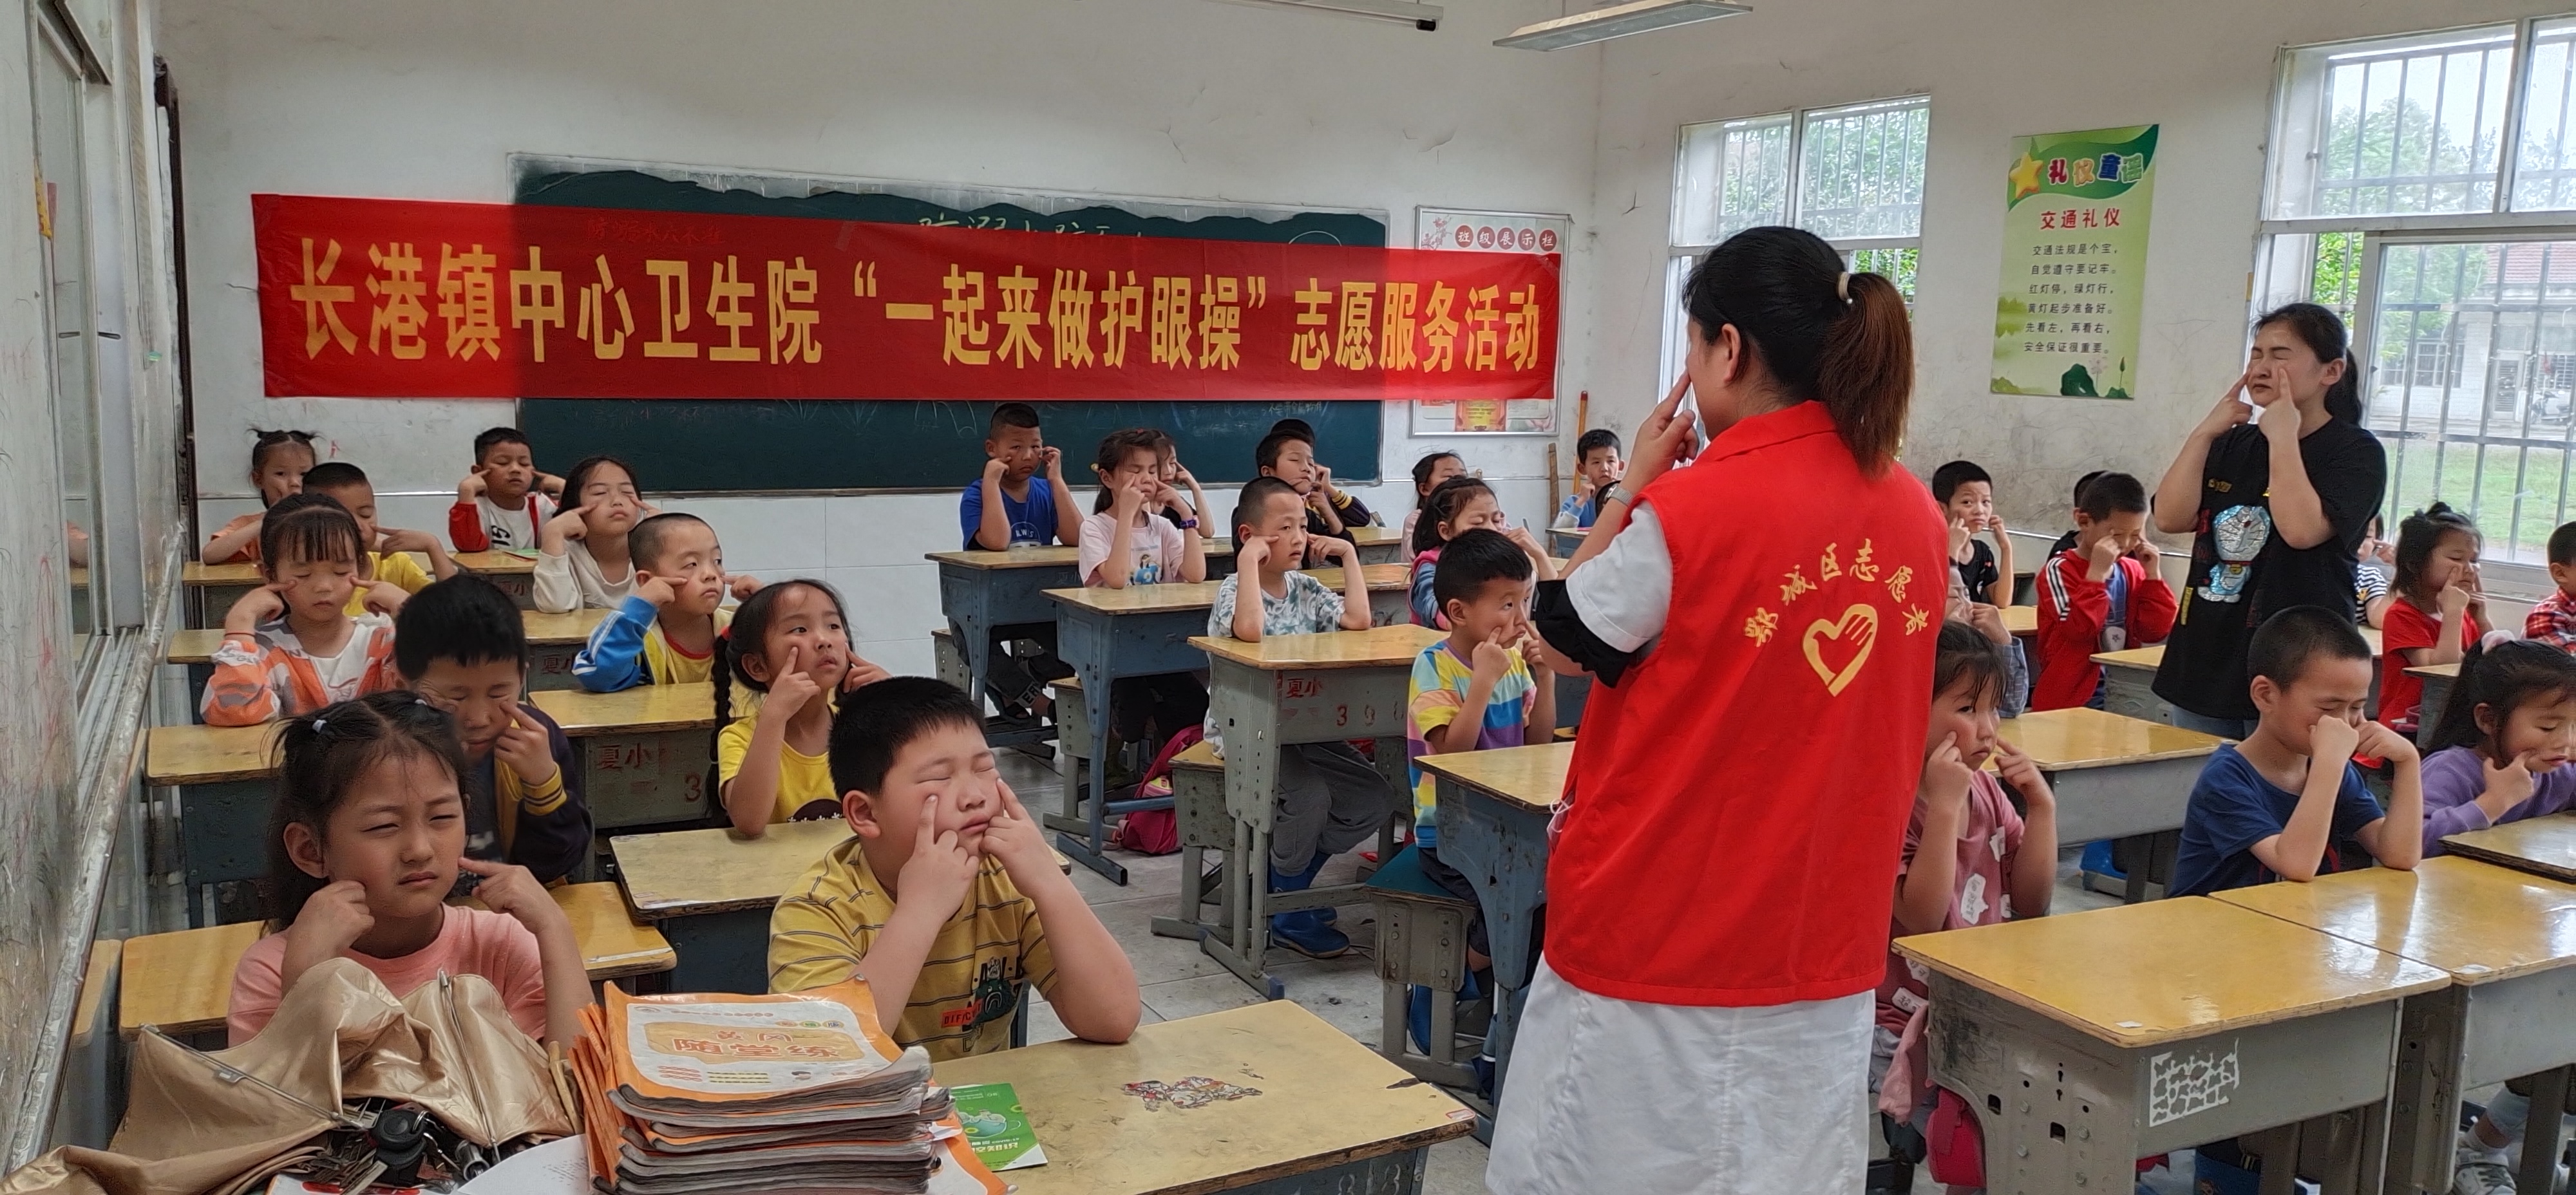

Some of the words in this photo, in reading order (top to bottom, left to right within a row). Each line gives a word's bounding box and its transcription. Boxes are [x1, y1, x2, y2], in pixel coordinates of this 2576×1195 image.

[2048, 153, 2143, 187] 礼仪童谣
[2040, 208, 2120, 231] 交通礼仪
[1456, 229, 1555, 249] 班级展示栏
[2032, 243, 2118, 256] 交通法规是个宝，
[2031, 263, 2116, 275] 自觉遵守要记牢。
[2029, 283, 2114, 294] 红灯停，绿灯行，
[290, 238, 1539, 371] 长港镇中心卫生院“一起来做护眼操”志愿服务活动
[2028, 303, 2112, 314] 黄灯起步准备好。
[2025, 322, 2110, 334] 先看左，再看右，
[2023, 341, 2108, 353] 安全保证很重要。
[1745, 538, 1929, 648] 鄂城区志愿者
[1286, 677, 1322, 699] 夏小
[1336, 706, 1347, 726] 3
[598, 743, 650, 771] 夏小
[684, 773, 701, 802] 3
[672, 1039, 838, 1057] 随堂练
